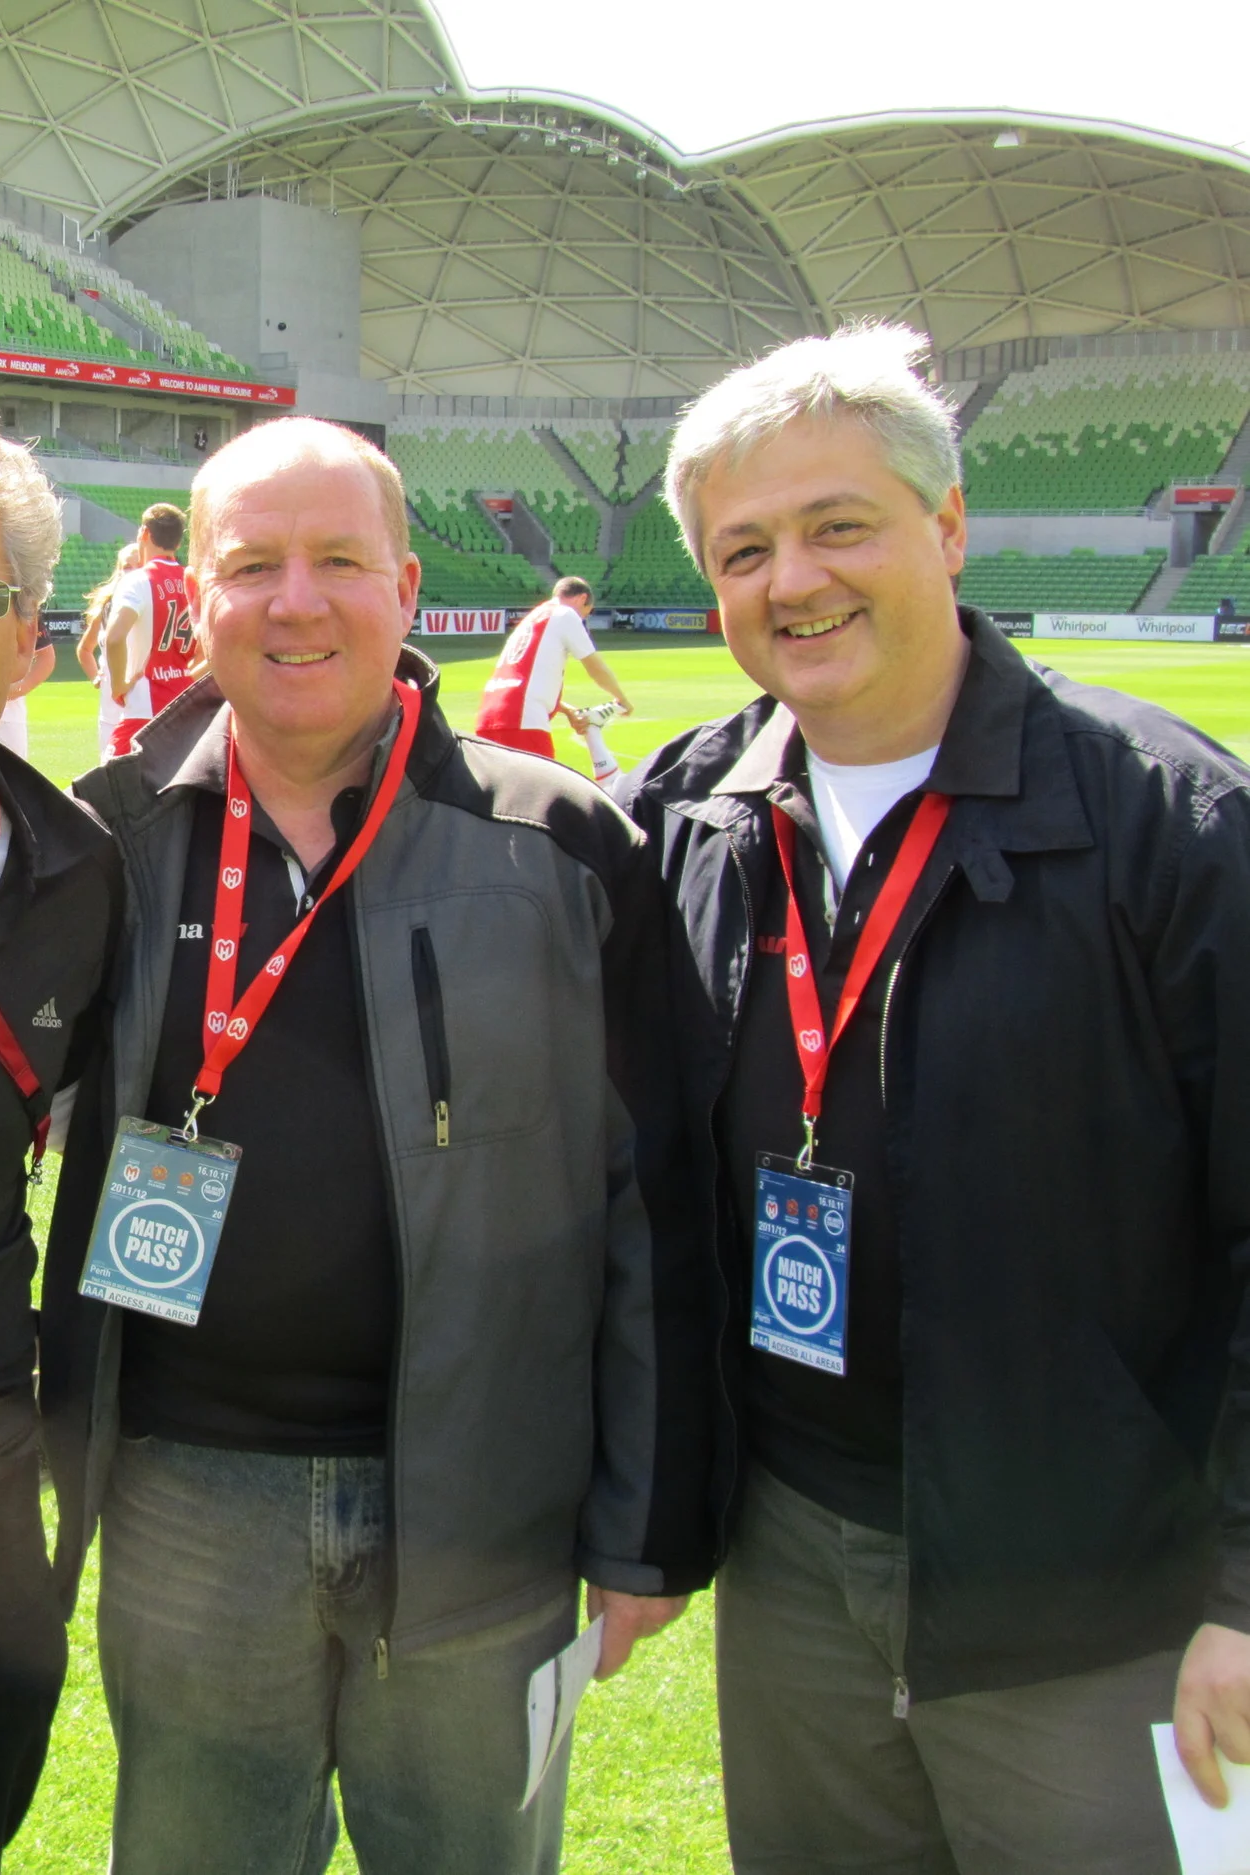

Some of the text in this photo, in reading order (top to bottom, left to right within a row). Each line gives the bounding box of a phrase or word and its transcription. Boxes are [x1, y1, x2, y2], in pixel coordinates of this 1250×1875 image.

[10, 360, 46, 373] MELBOURNE
[159, 378, 252, 397] WELCOME TO AAMI PARK MELBOURNE
[158, 599, 193, 654] 14
[635, 612, 705, 629] FOX SPORTS
[1051, 620, 1107, 634] Whirlpool
[1137, 621, 1196, 636] Whirlpool
[152, 665, 182, 682] Alpha
[32, 1016, 62, 1028] adidas
[197, 1165, 229, 1181] 16.10.11
[110, 1182, 148, 1200] 2011/12
[212, 1210, 223, 1220] 20
[129, 1216, 189, 1248] MATCH
[758, 1220, 787, 1237] 2011/12
[124, 1235, 183, 1272] PASS
[836, 1243, 846, 1253] 24
[90, 1264, 111, 1278] Perth
[778, 1255, 823, 1289] MATCH
[85, 1286, 104, 1298] AAA
[777, 1277, 821, 1315] PASS
[108, 1292, 196, 1323] ACCESS ALL AREAS
[771, 1341, 799, 1358] ACCESS
[800, 1351, 813, 1363] ALL
[815, 1355, 841, 1372] AREAS
